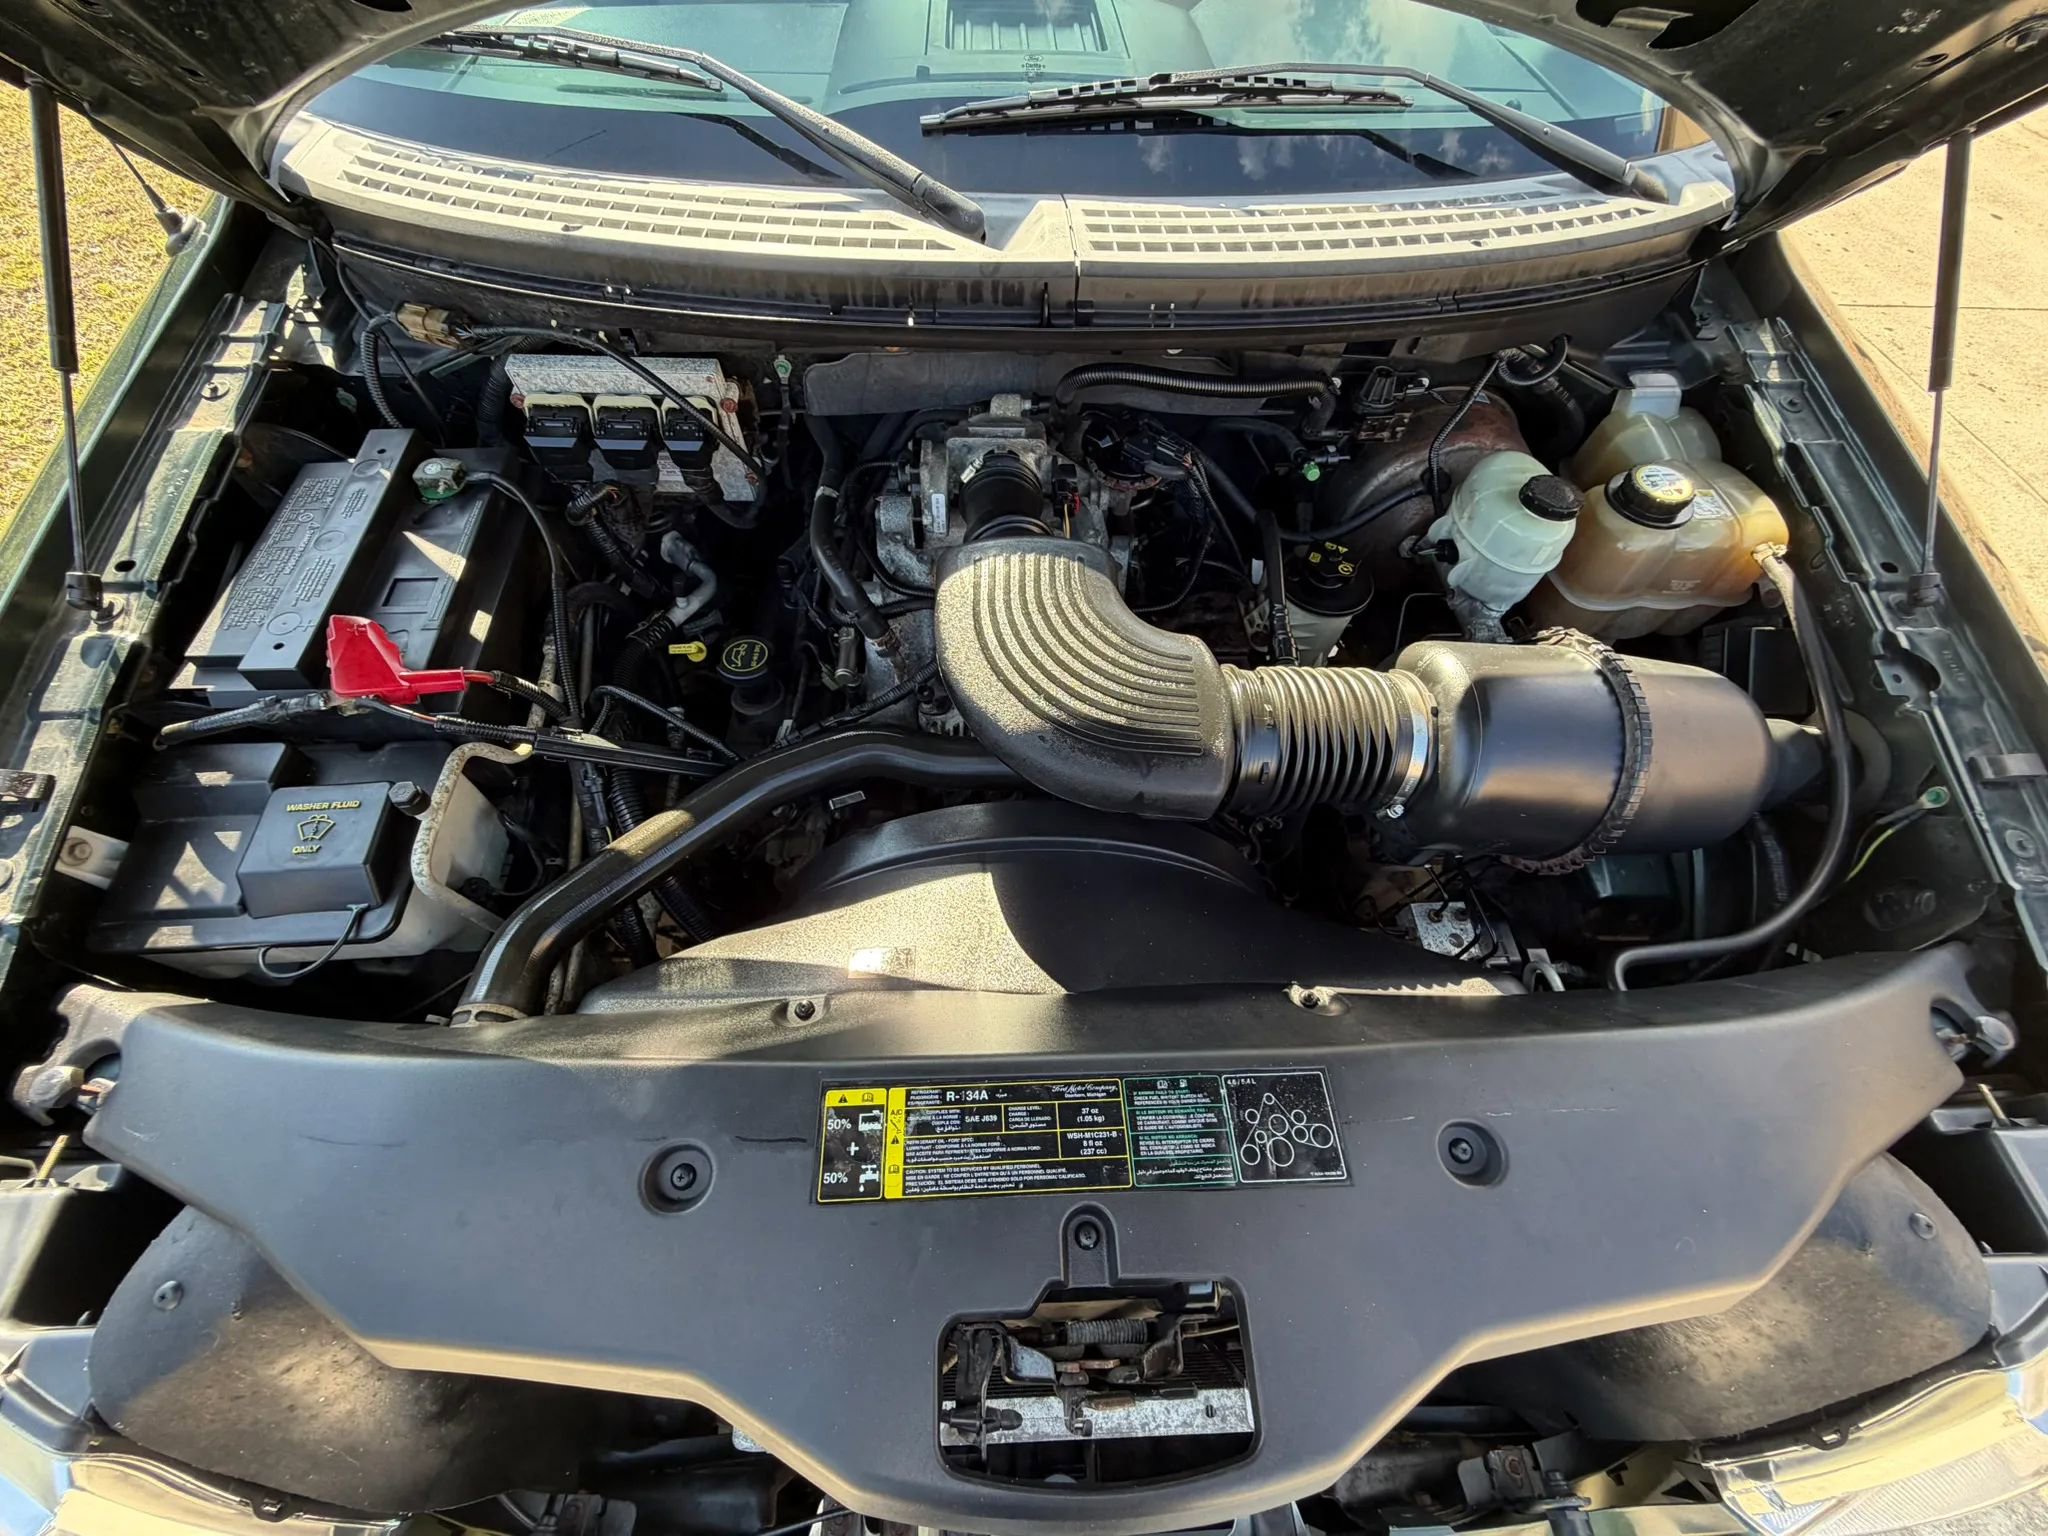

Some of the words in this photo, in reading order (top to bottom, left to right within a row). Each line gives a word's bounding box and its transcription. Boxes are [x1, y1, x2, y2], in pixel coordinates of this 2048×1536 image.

[286, 802, 330, 812] WASHER
[331, 800, 360, 810] FLUID
[292, 845, 321, 854] ONLY
[827, 1118, 851, 1130] 50%
[1096, 1147, 1107, 1155] cc)
[823, 1172, 848, 1184] 50%
